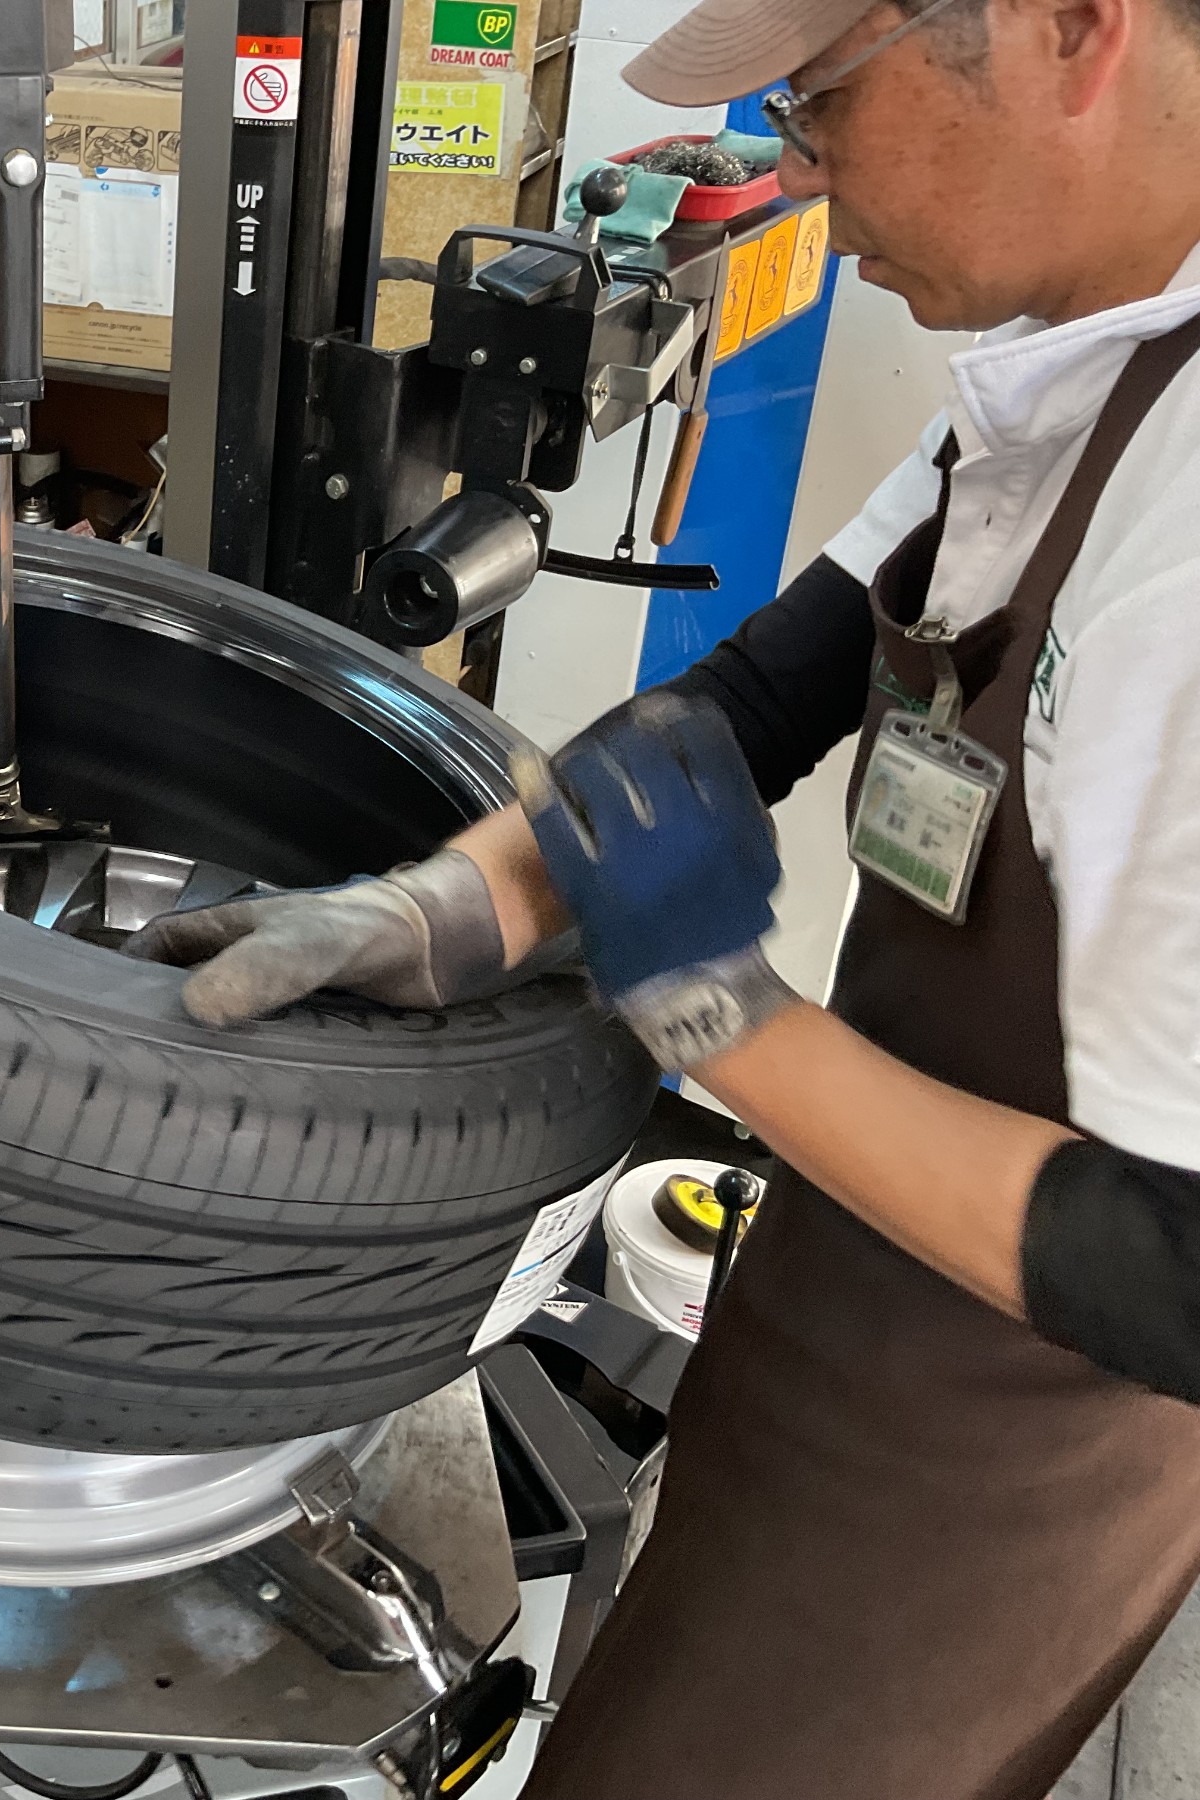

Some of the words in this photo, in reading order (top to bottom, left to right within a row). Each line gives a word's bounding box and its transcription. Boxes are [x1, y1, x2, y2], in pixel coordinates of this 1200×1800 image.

[482, 15, 508, 34] BP
[431, 48, 475, 66] DREAM
[479, 51, 510, 68] COAT
[396, 123, 490, 144] ウエイト
[236, 184, 264, 209] UP
